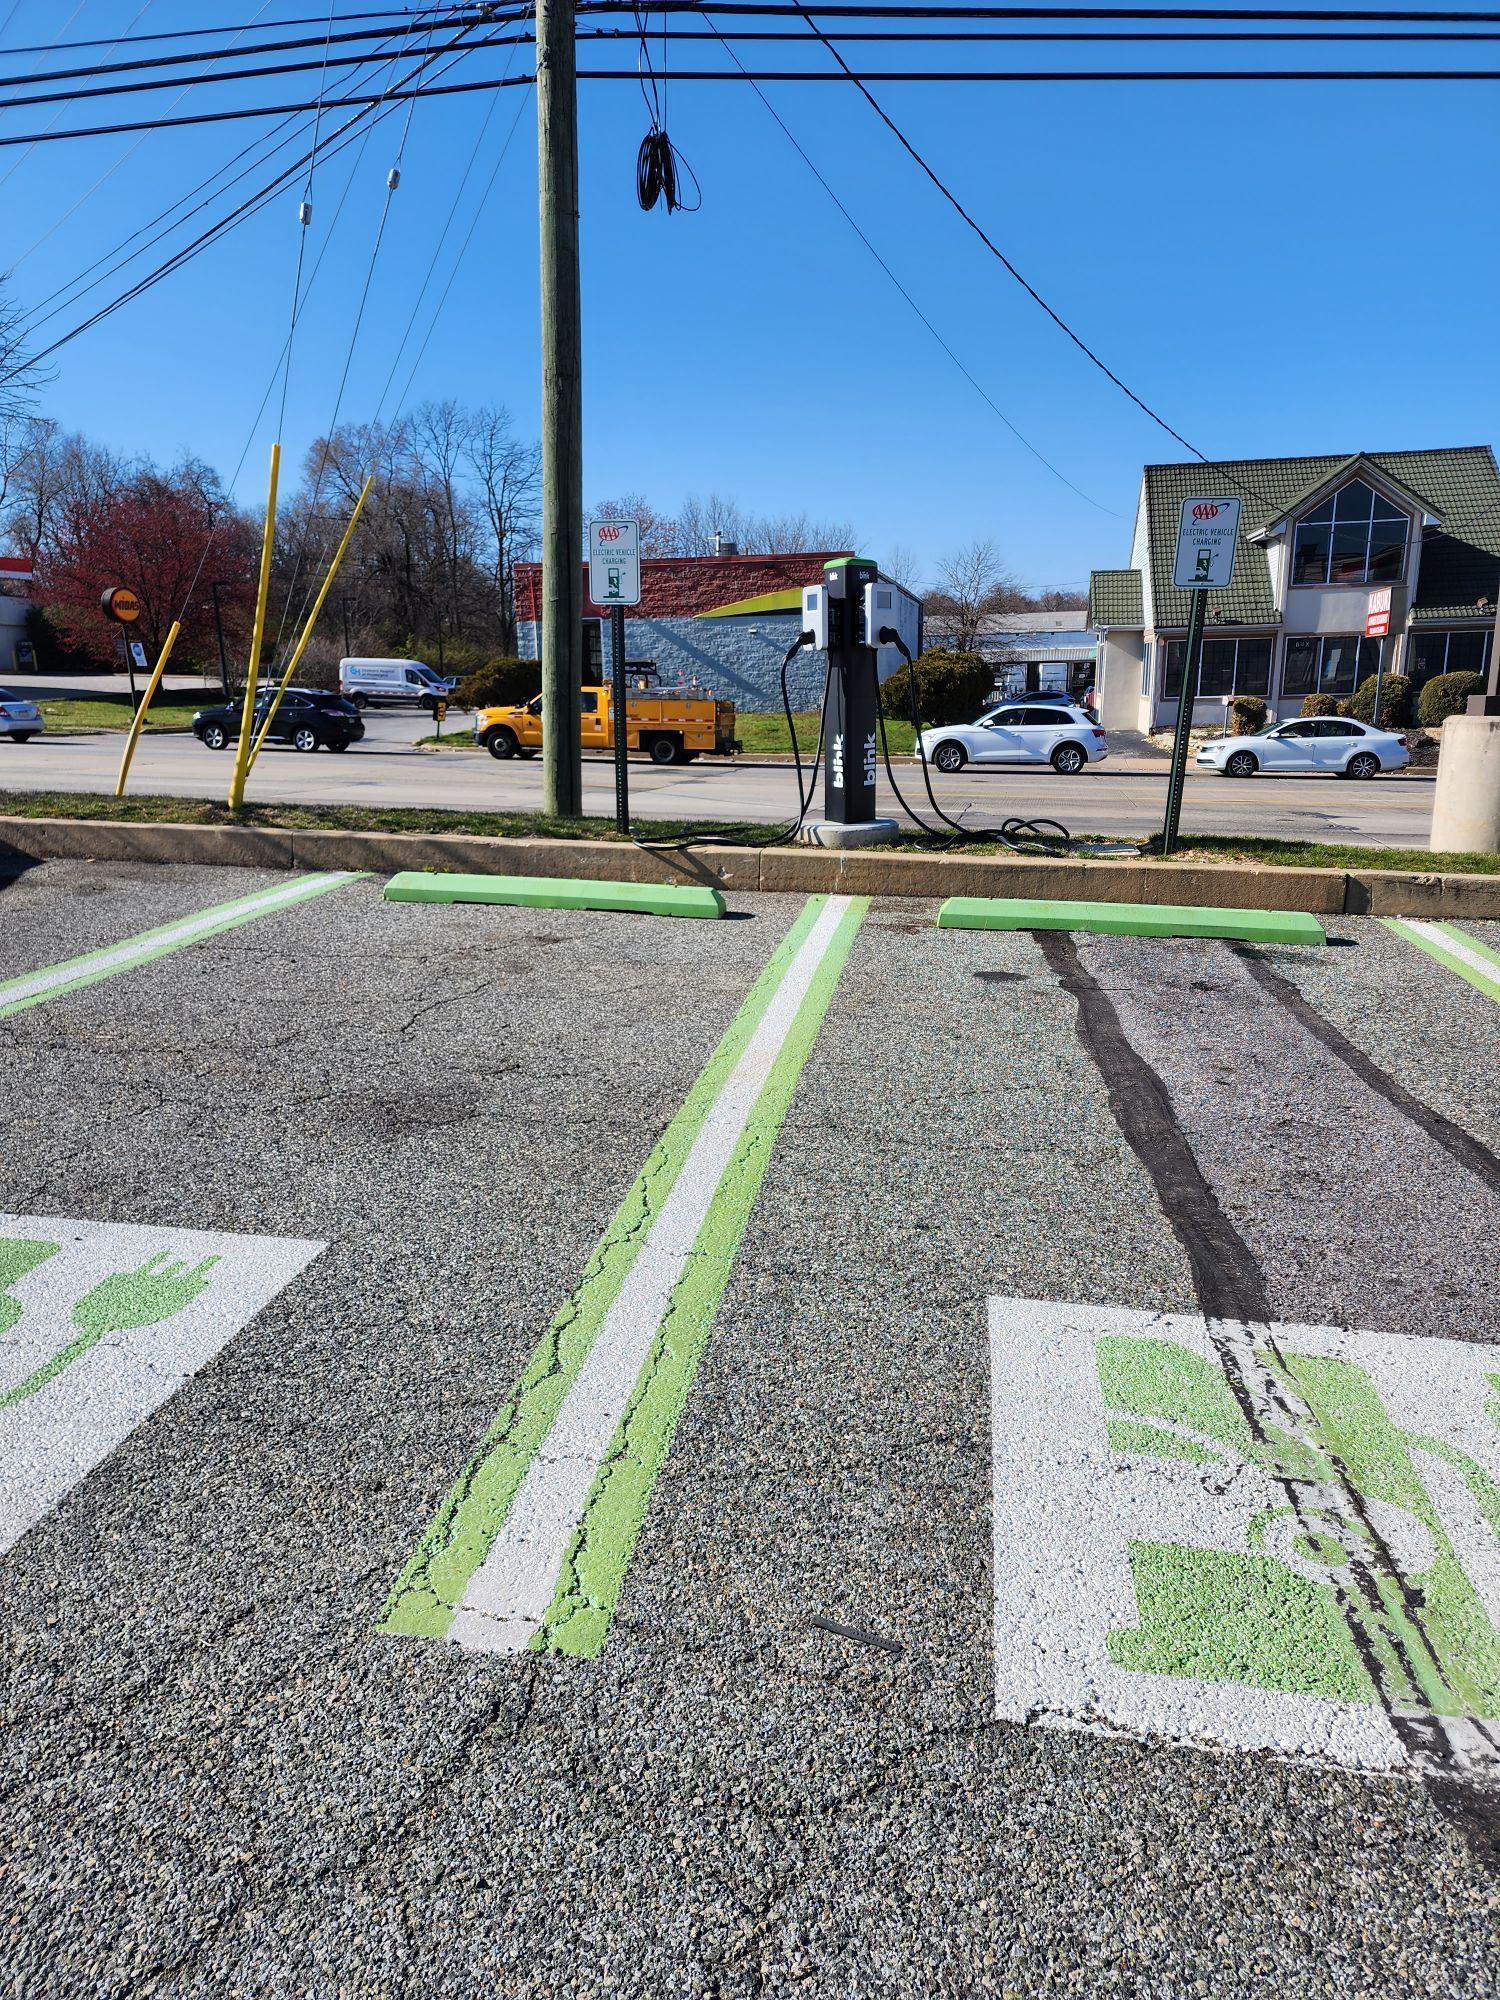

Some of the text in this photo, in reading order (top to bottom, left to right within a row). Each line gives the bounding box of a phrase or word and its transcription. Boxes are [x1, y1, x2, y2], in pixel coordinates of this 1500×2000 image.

[1193, 503, 1218, 520] AAA
[599, 526, 619, 541] AAA
[833, 734, 844, 788] blink
[864, 732, 876, 786] blink
